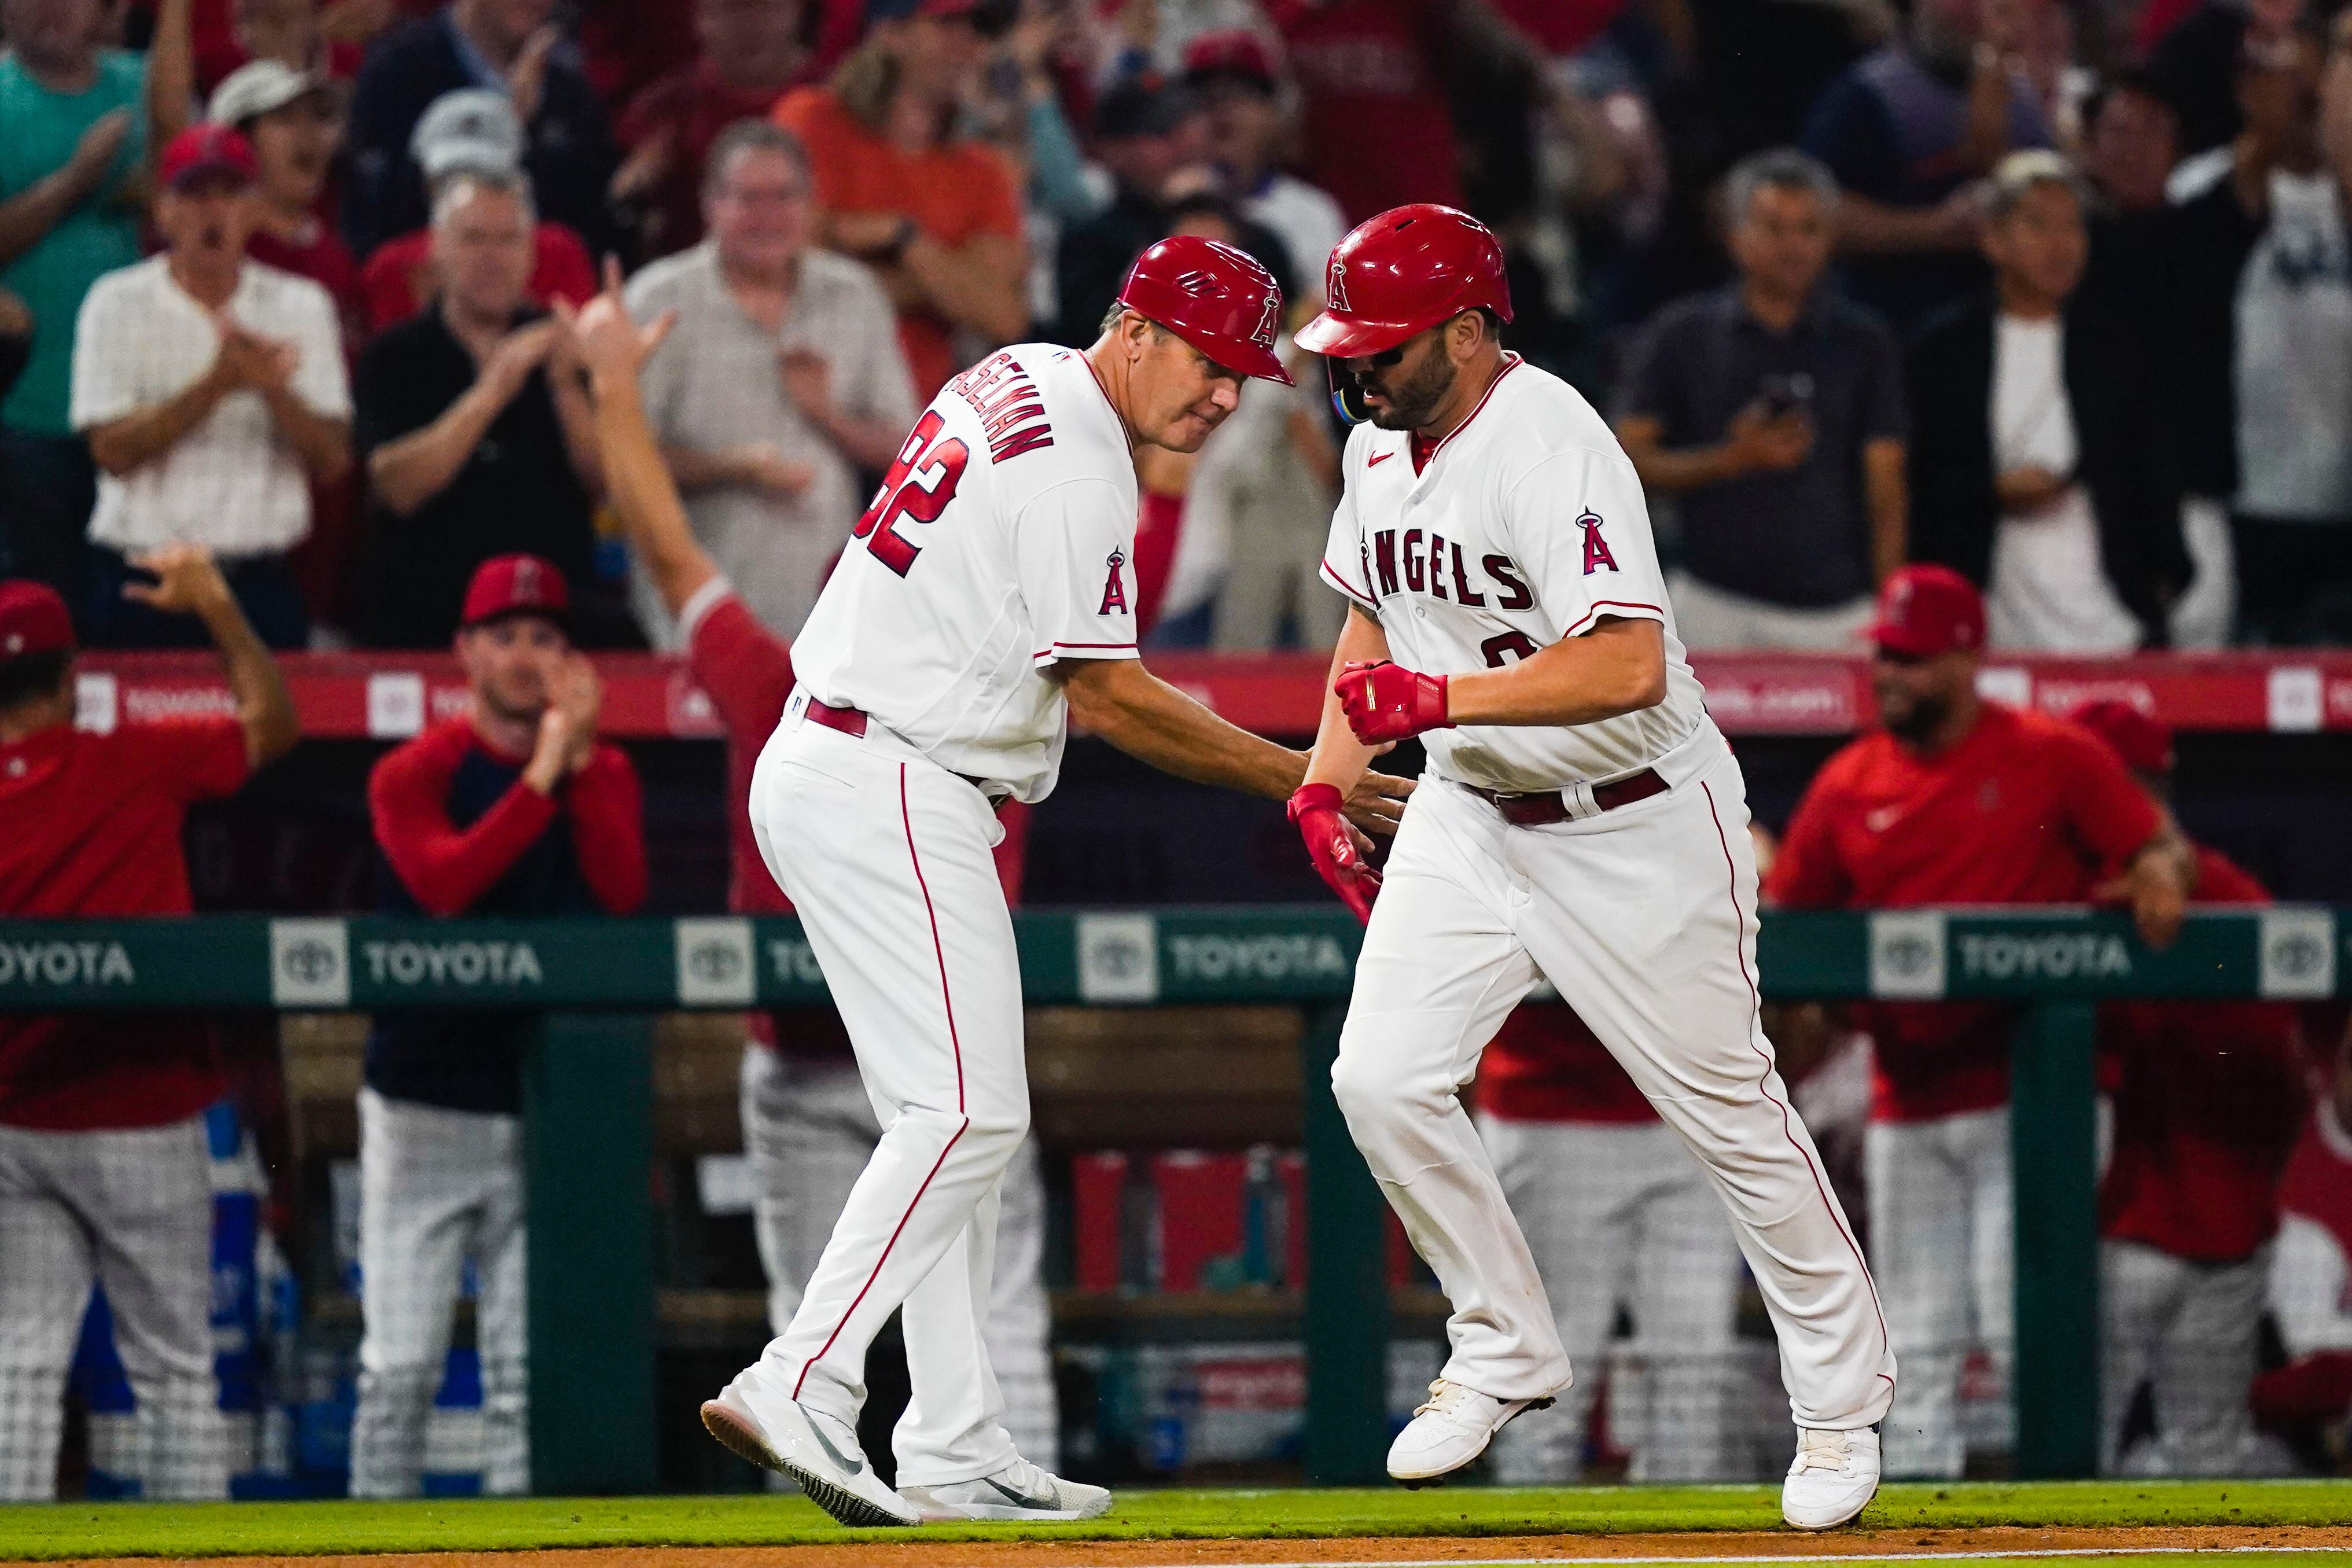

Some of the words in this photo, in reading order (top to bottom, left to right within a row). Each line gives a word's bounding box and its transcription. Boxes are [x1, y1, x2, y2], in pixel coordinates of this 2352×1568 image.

[1328, 255, 1352, 312] A
[1250, 289, 1278, 345] A
[1576, 505, 1619, 576] A
[1098, 544, 1128, 615] A
[362, 940, 543, 985] TOYOTA
[1169, 933, 1349, 981] TOYOTA
[1958, 932, 2133, 980] TOYOTA
